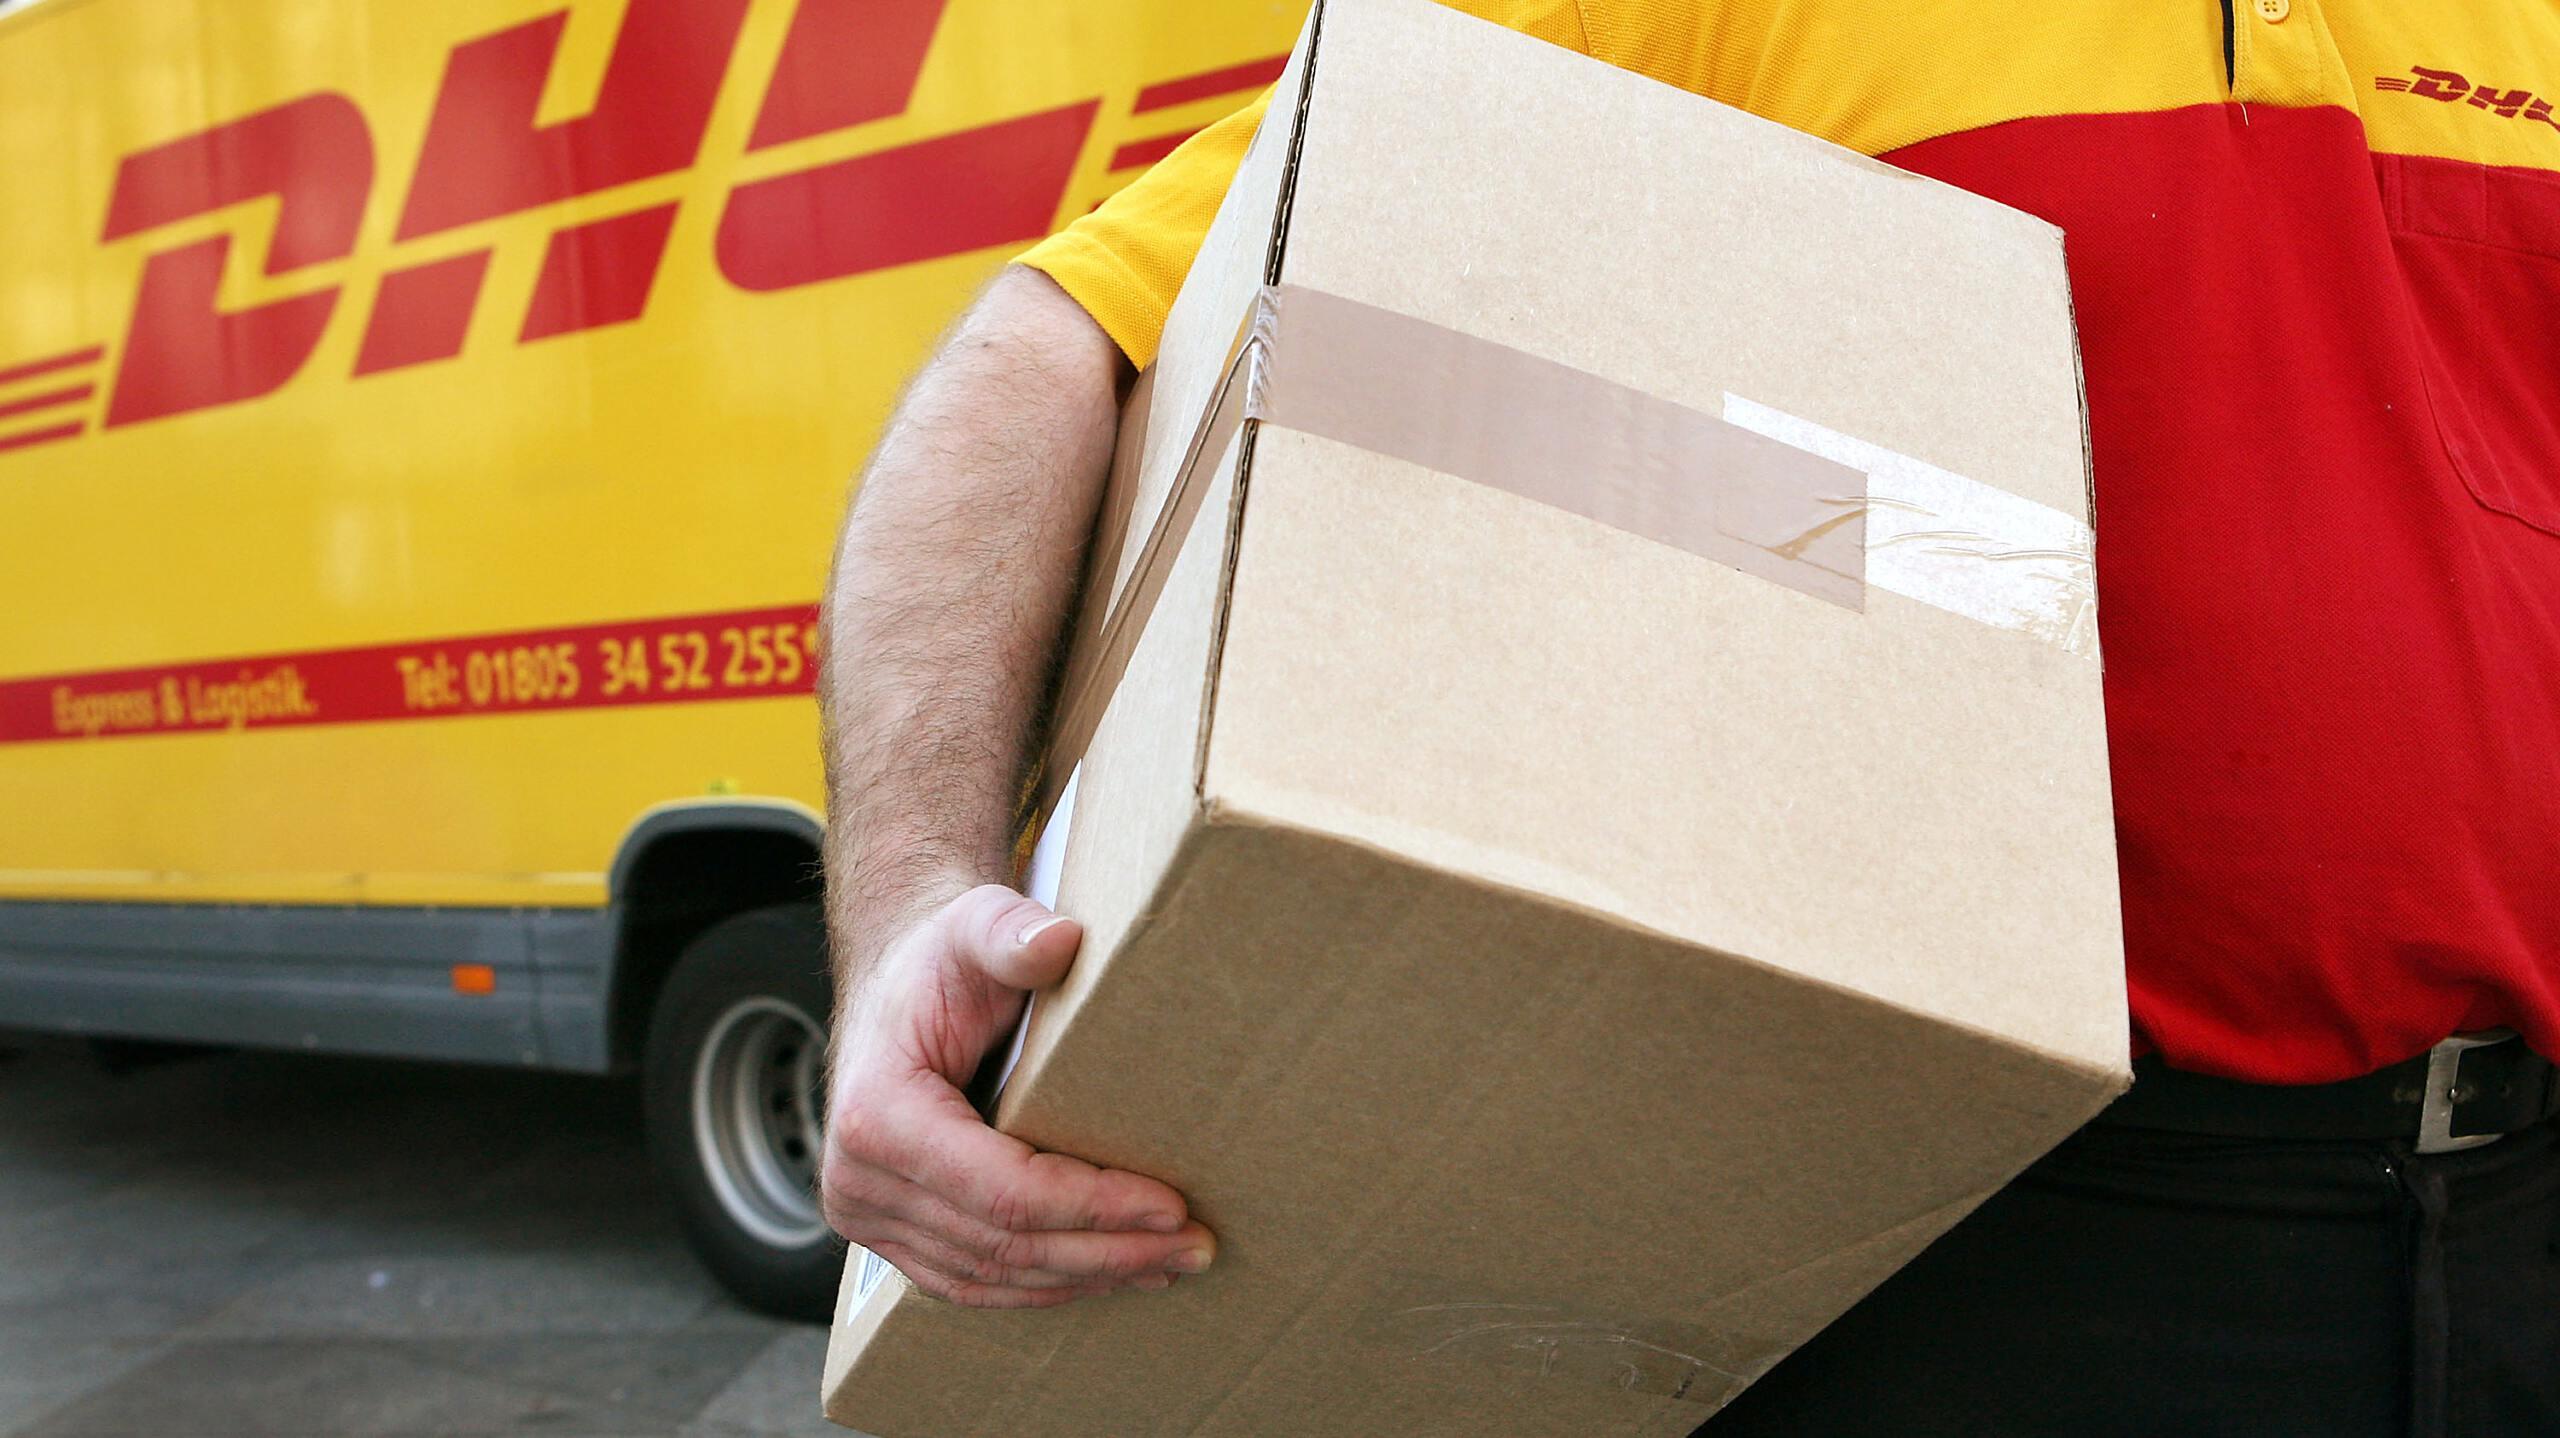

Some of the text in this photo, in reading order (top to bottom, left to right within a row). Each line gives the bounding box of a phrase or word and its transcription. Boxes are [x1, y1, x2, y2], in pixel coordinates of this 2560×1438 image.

[2409, 65, 2560, 133] DHL
[99, 0, 1104, 431] DHL
[466, 643, 580, 705] 01805
[598, 638, 649, 695] 34
[658, 631, 712, 692] 52
[53, 685, 156, 736] Express
[159, 676, 184, 725] &
